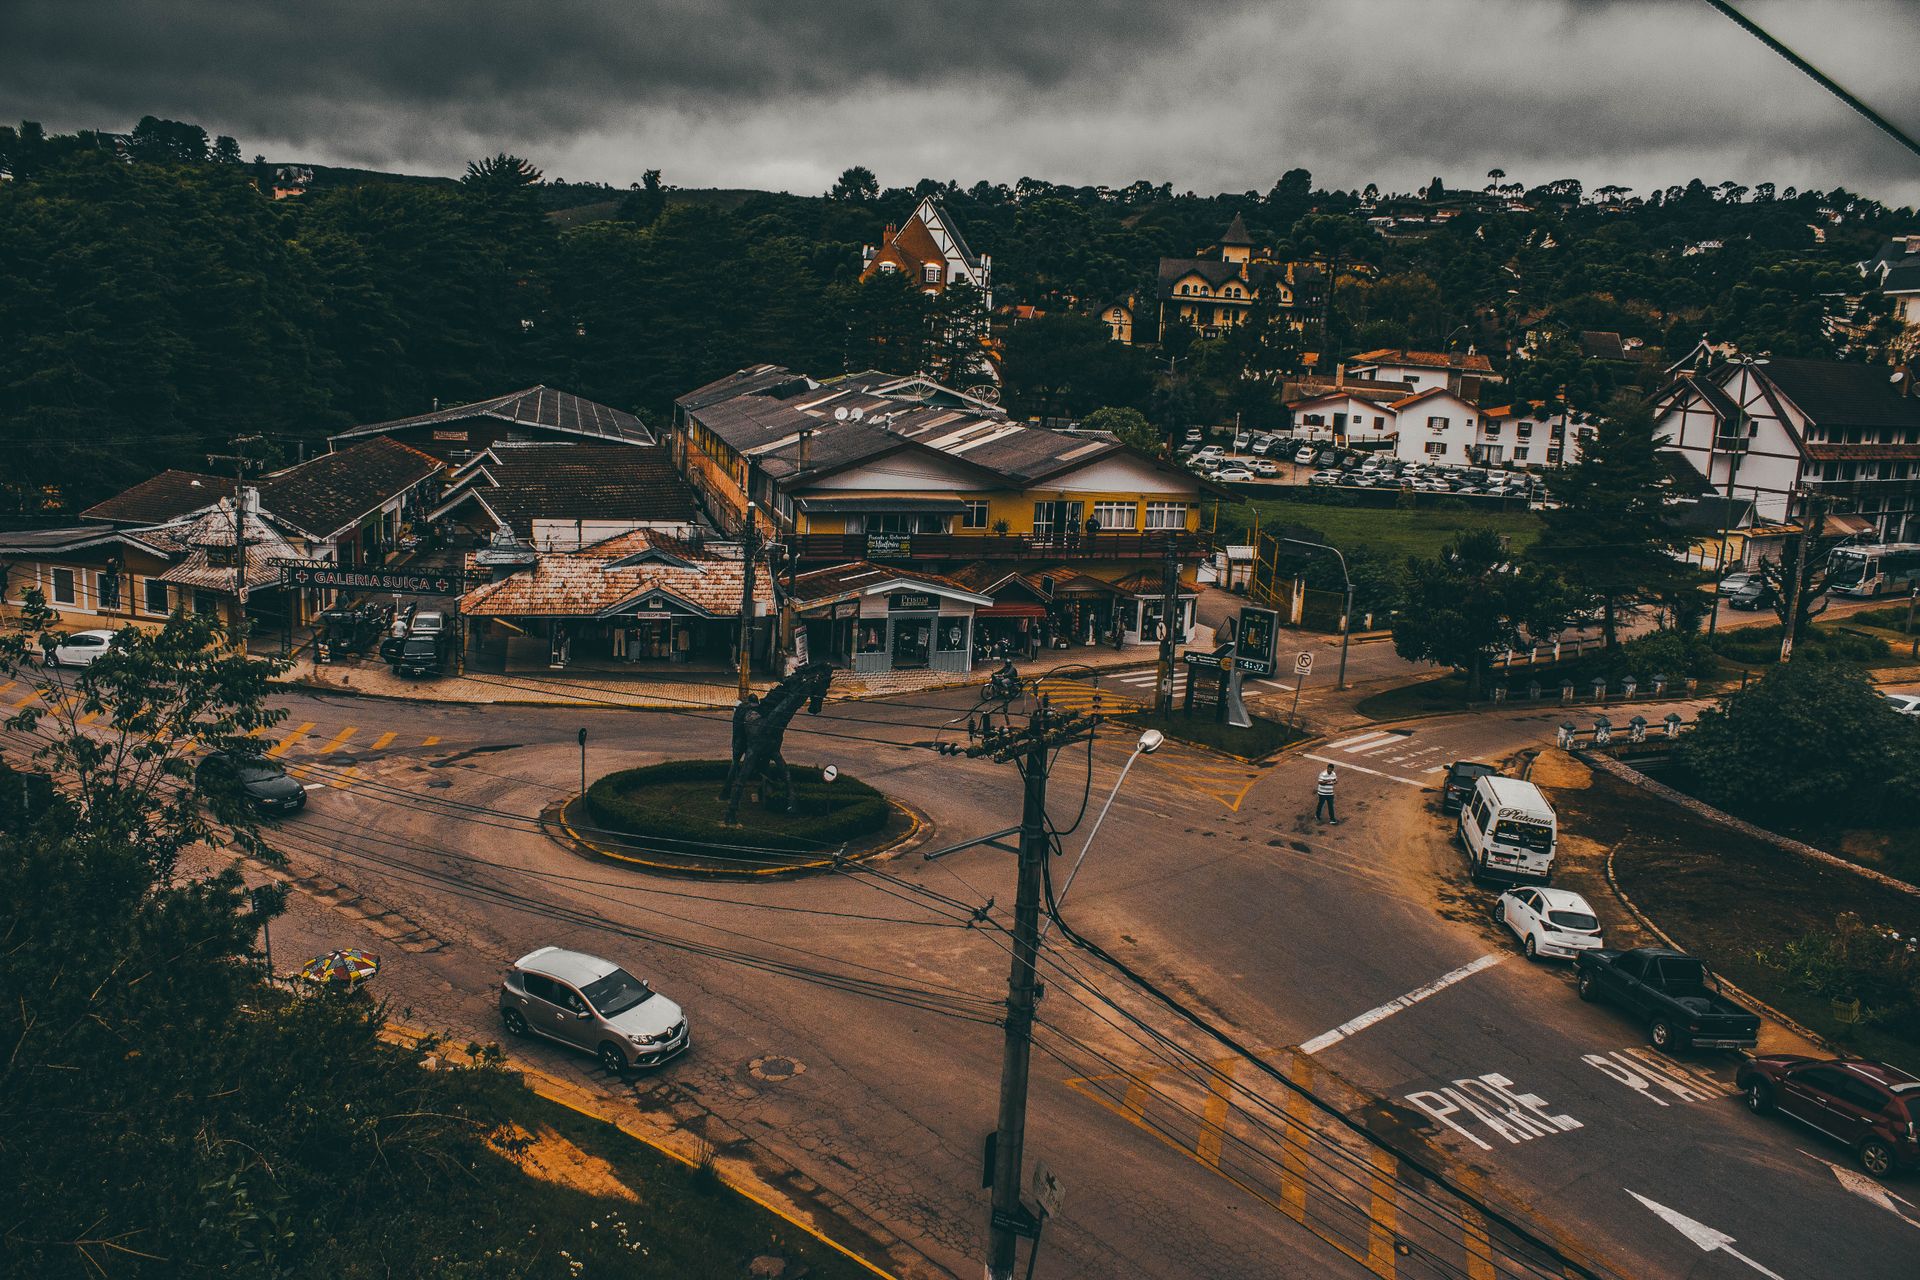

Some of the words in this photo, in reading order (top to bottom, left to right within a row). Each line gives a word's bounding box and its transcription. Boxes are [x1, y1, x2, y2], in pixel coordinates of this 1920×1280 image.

[314, 572, 381, 587] GALERIA
[901, 595, 929, 603] Prisma
[1498, 808, 1552, 825] Platanus
[1404, 1073, 1584, 1150] PARE
